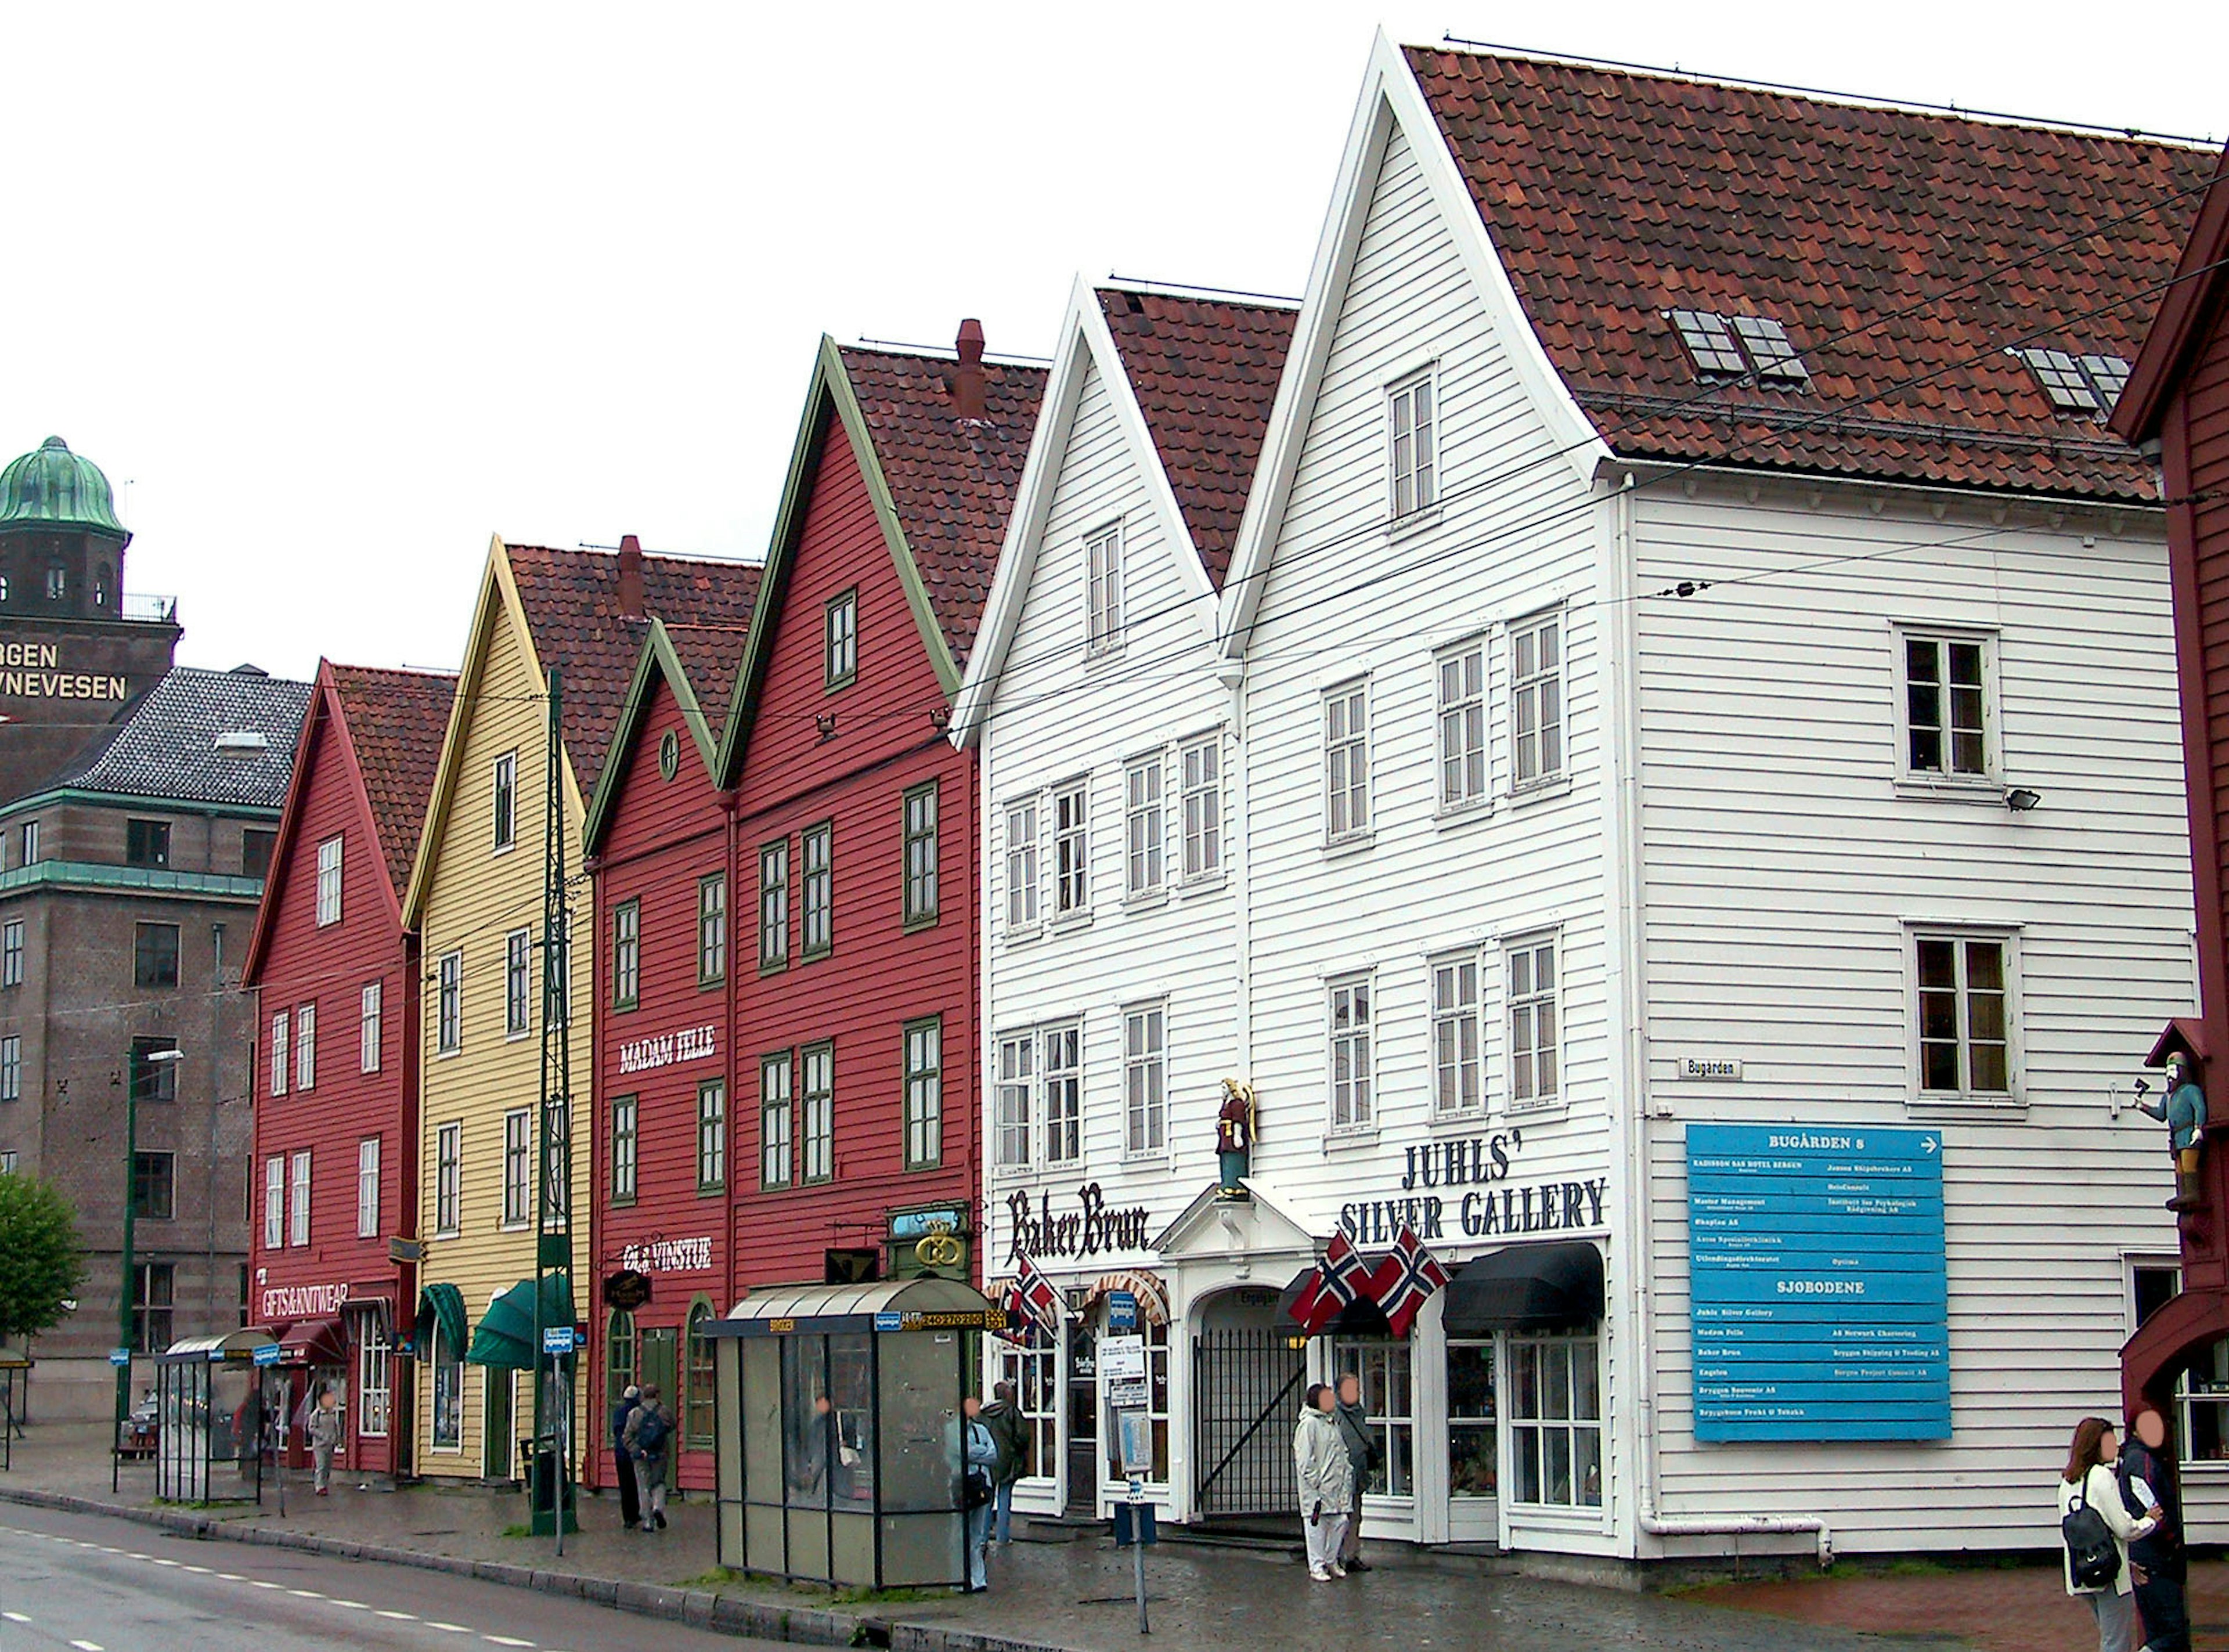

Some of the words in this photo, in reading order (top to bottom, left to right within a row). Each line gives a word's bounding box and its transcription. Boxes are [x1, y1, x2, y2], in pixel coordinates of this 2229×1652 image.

[619, 1034, 674, 1074] MADAM
[676, 1025, 715, 1062] FELLE
[1769, 1132, 1850, 1149] BUGÅRDEN
[1341, 1196, 1444, 1245] SILVER
[1461, 1177, 1606, 1236] GALLERY
[1745, 1308, 1773, 1318] Gallery
